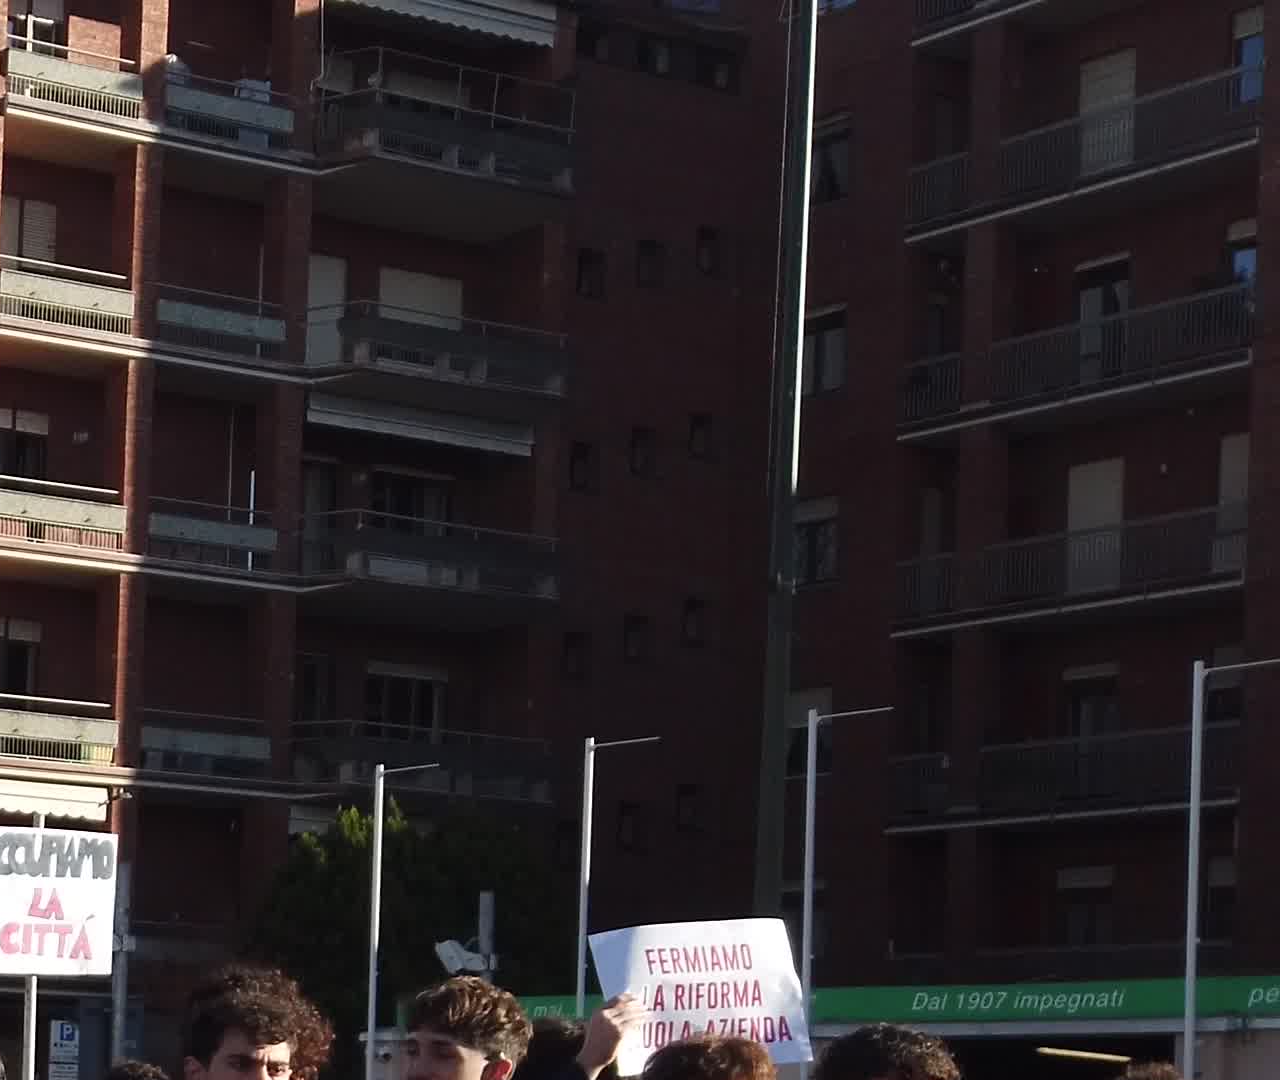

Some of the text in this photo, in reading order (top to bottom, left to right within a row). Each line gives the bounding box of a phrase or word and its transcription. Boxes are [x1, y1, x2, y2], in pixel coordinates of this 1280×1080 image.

[27, 887, 65, 921] LA
[645, 943, 753, 976] FERMIAMO
[674, 979, 763, 1011] RIFORMA
[911, 992, 948, 1010] Dal
[955, 991, 1008, 1010] 1907
[1013, 987, 1126, 1014] impegnati
